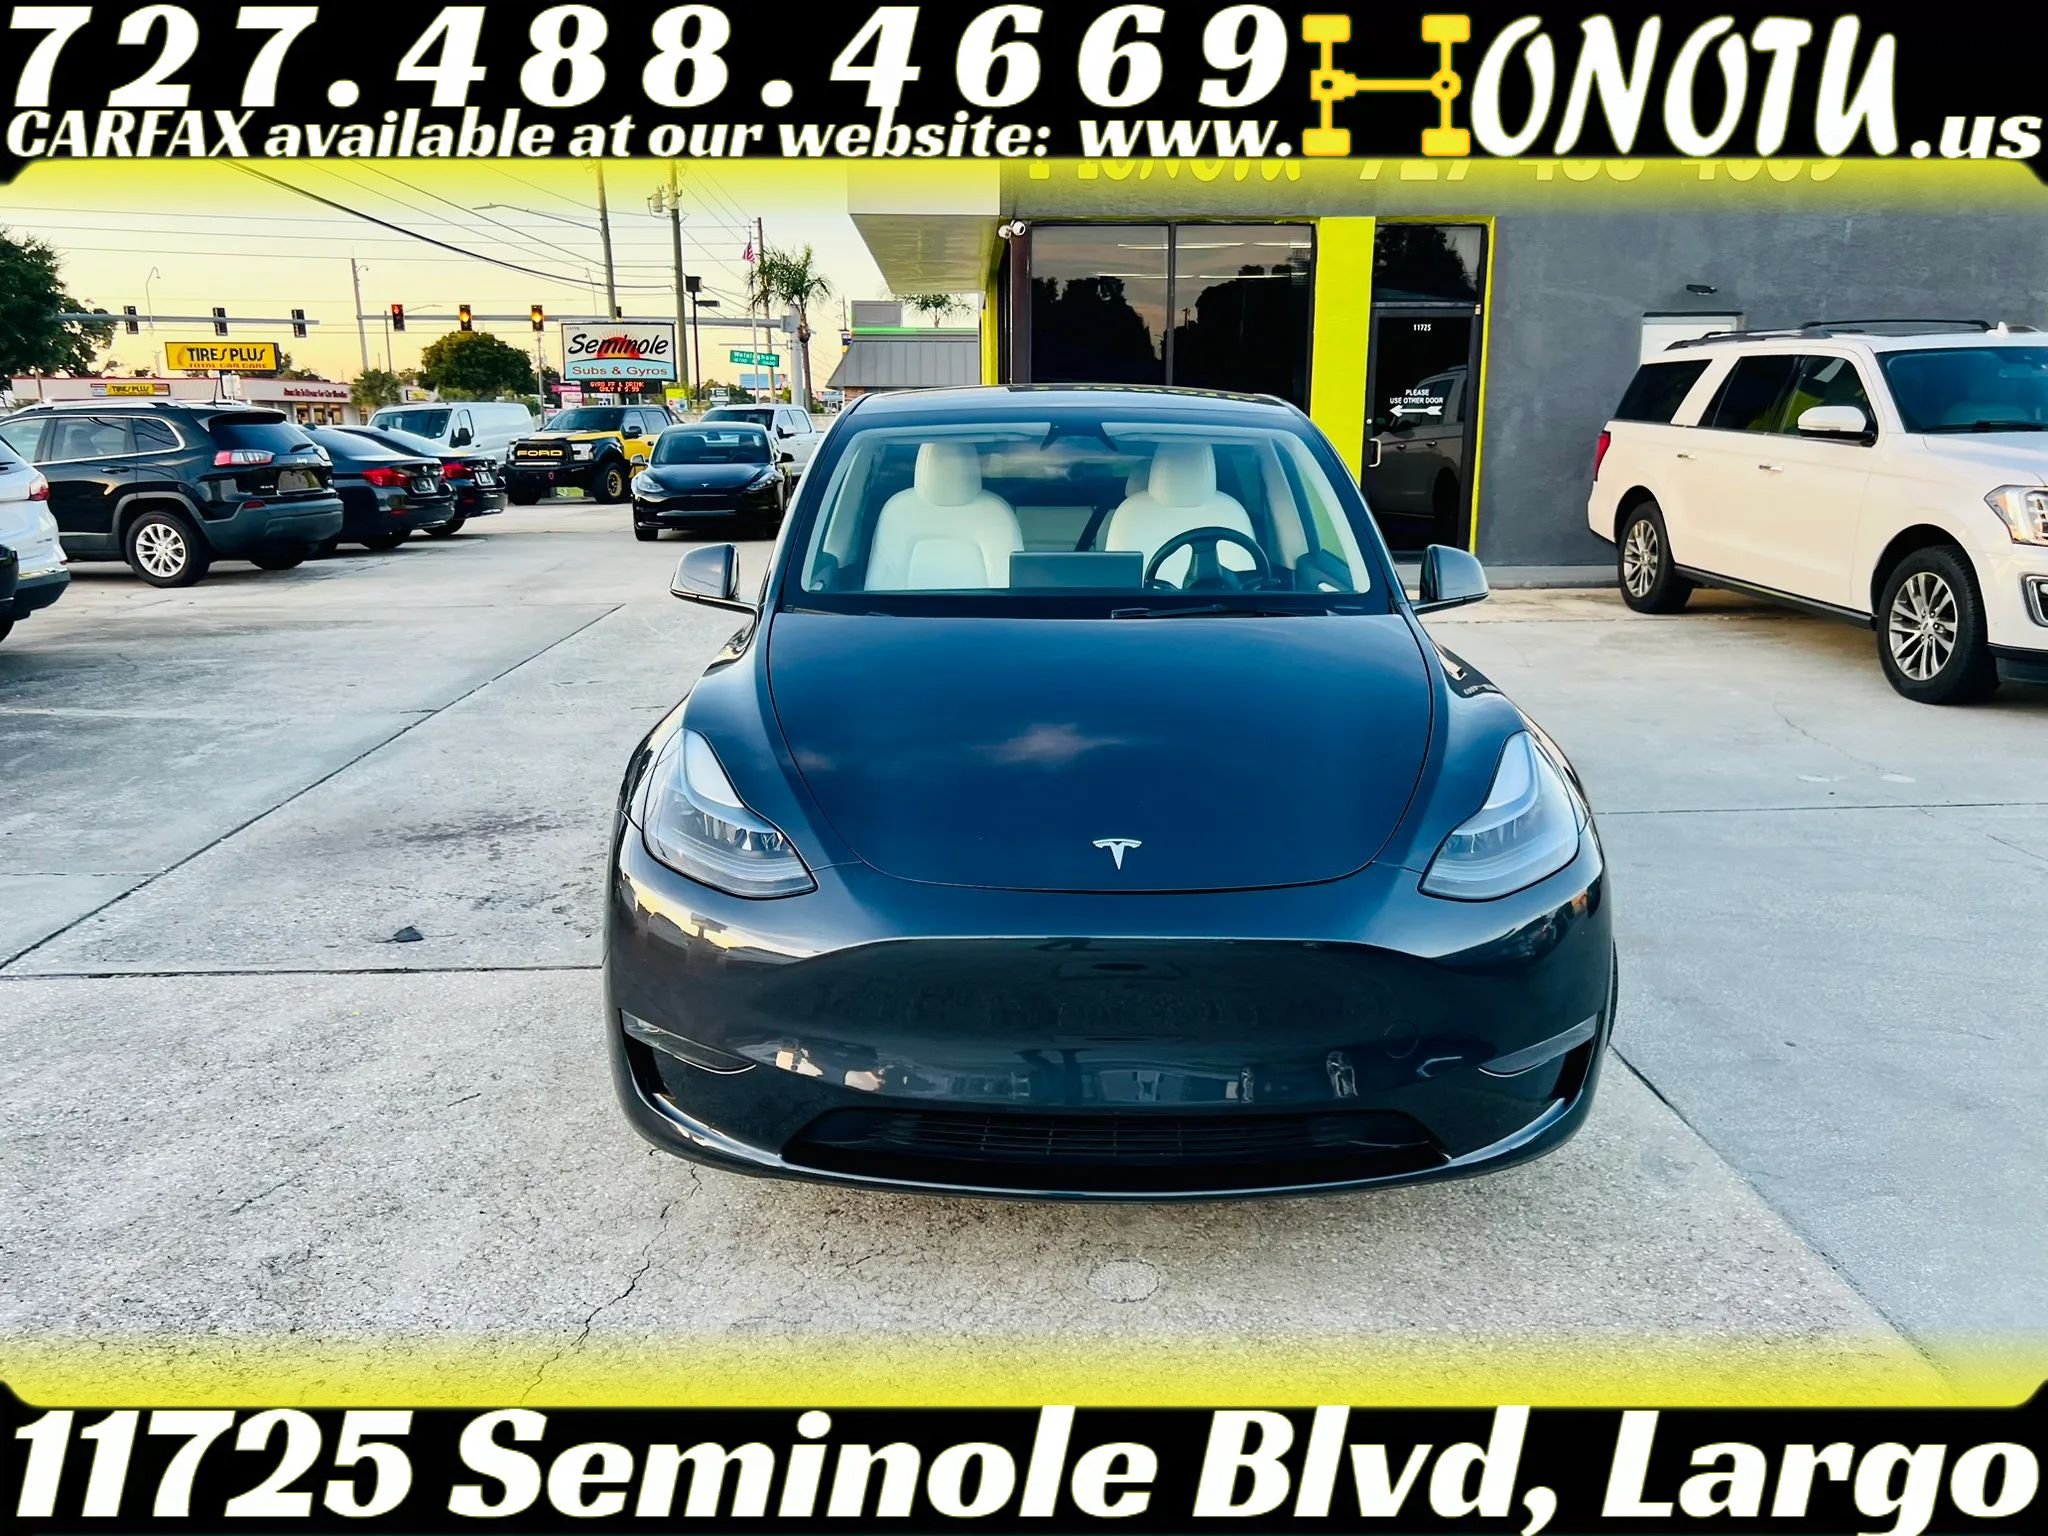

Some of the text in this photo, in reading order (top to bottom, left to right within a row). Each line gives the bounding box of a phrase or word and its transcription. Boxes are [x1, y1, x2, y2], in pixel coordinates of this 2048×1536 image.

[568, 334, 668, 354] Seminole
[187, 348, 266, 361] TIRES PLUS
[572, 366, 667, 377] Subs & Gyros
